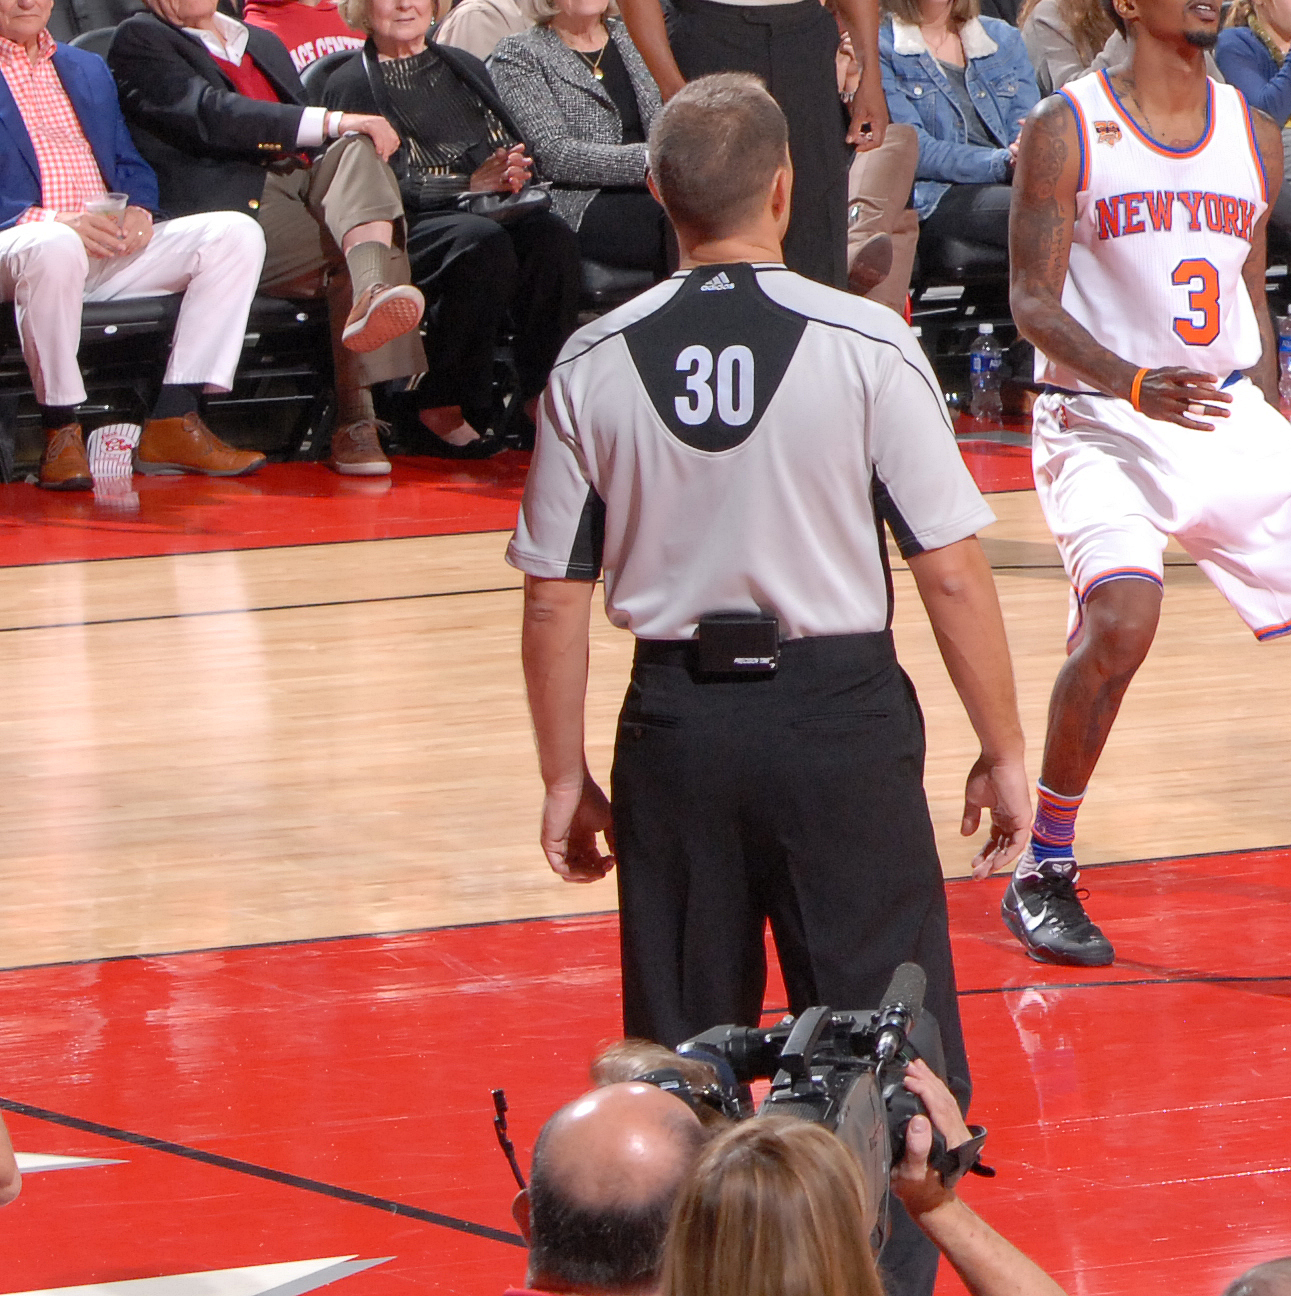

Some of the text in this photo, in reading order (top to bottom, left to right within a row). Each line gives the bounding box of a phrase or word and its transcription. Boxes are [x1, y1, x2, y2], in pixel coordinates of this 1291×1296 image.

[1095, 190, 1257, 243] NEW YORK
[1171, 257, 1221, 347] 3
[674, 344, 755, 426] 30
